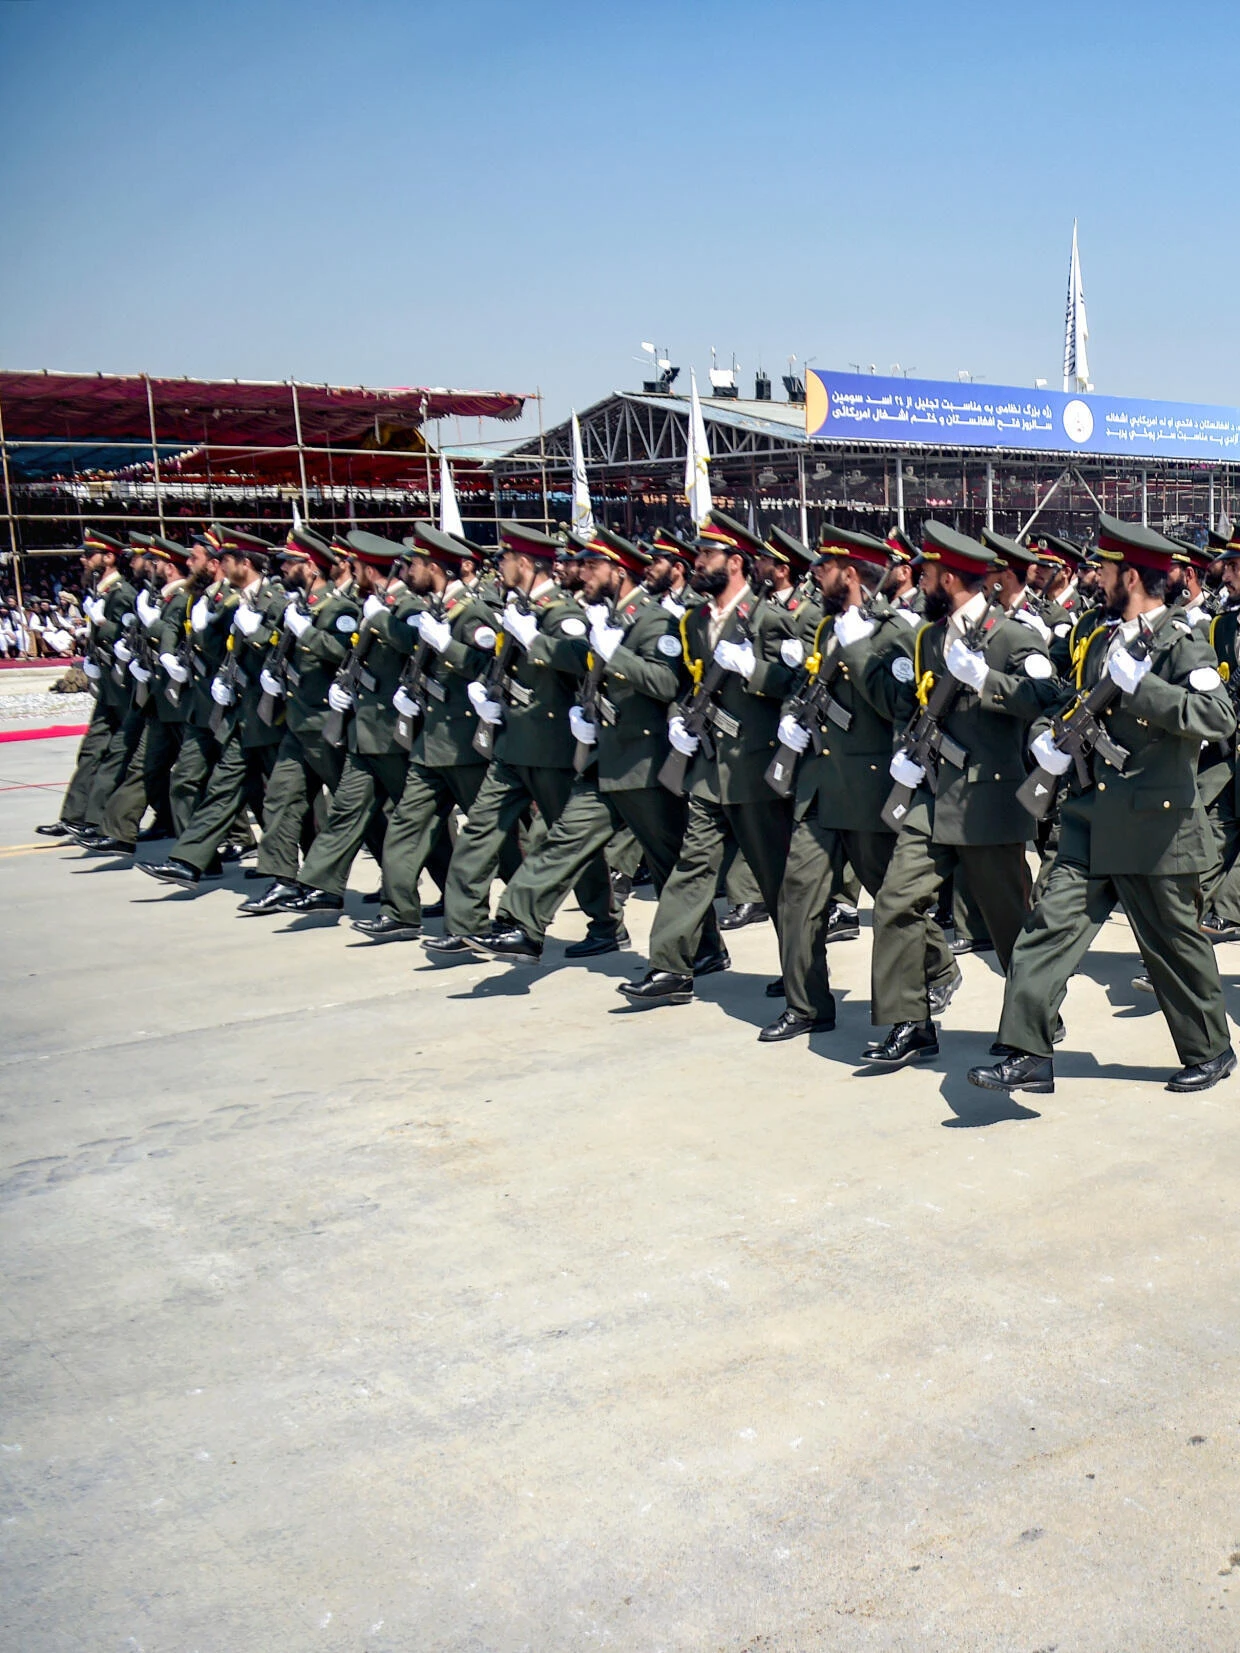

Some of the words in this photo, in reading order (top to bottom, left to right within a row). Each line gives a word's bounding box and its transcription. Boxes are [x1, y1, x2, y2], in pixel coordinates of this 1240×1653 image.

[832, 390, 863, 404] سومین
[865, 394, 892, 405] اسد
[906, 396, 912, 409] از
[941, 400, 982, 412] مناسبت
[984, 404, 993, 414] به
[872, 408, 908, 422] اشغال
[910, 411, 937, 424] ختم
[939, 416, 944, 426] و
[946, 414, 995, 427] افغانستان
[997, 417, 1020, 431] فتح
